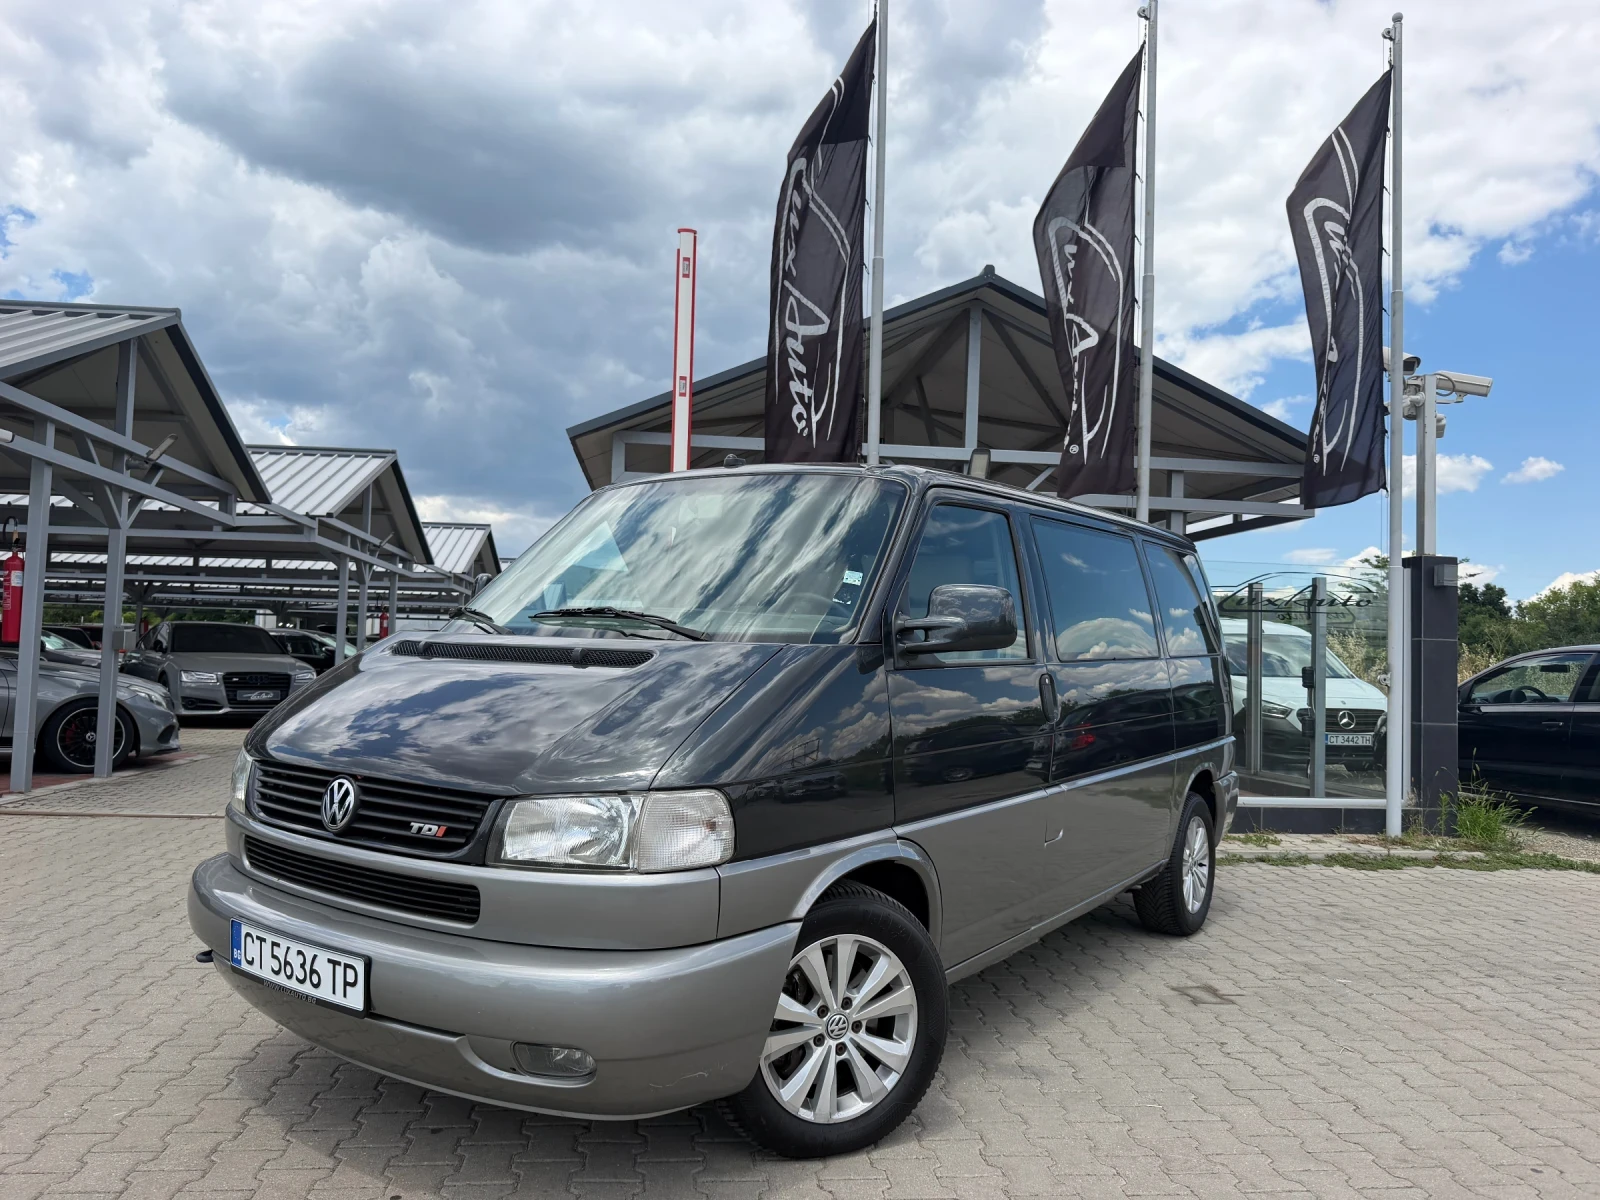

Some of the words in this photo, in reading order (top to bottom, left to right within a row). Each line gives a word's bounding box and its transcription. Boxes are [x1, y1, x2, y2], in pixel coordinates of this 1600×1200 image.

[1329, 735, 1339, 744] CT
[1340, 735, 1360, 745] 3442
[243, 931, 267, 970] CT
[270, 940, 322, 989] 5636
[327, 957, 358, 999] TP
